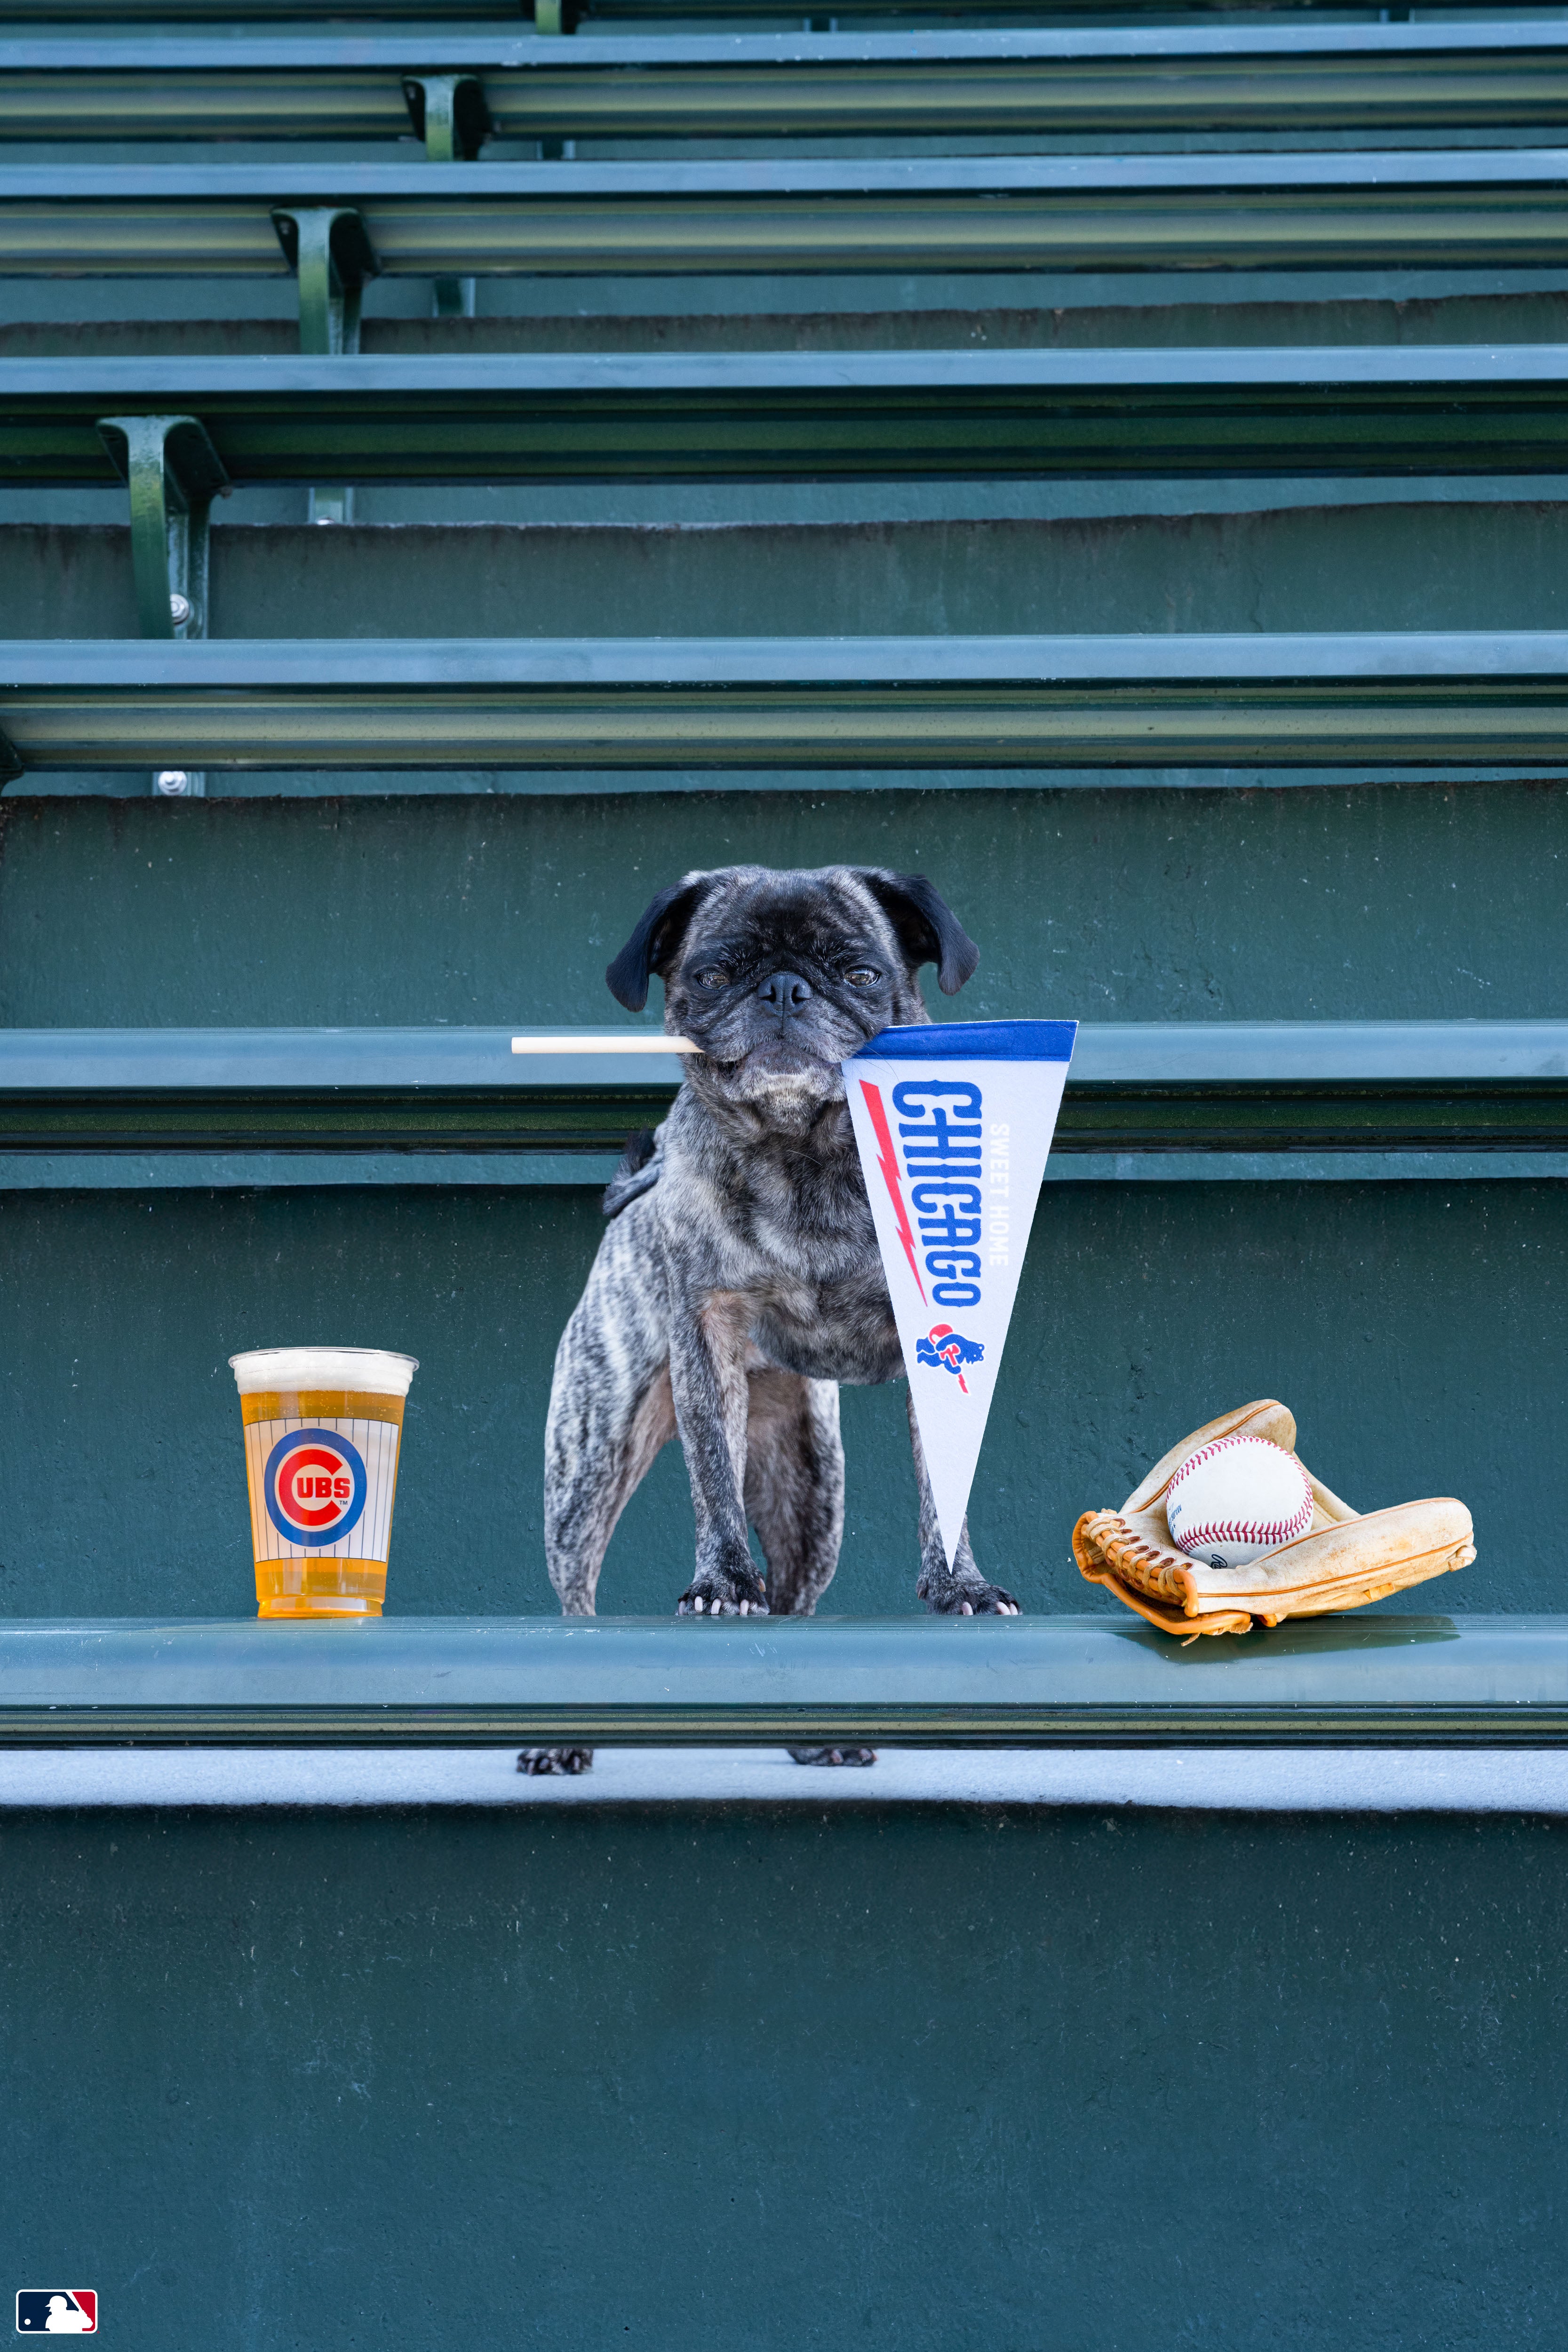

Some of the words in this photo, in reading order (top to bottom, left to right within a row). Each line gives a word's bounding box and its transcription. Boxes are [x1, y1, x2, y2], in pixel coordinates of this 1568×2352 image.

[892, 1079, 982, 1308] CHICAGO
[989, 1123, 1010, 1198] SWEET
[989, 1206, 1010, 1266] HOME
[279, 1449, 350, 1526] CUBS
